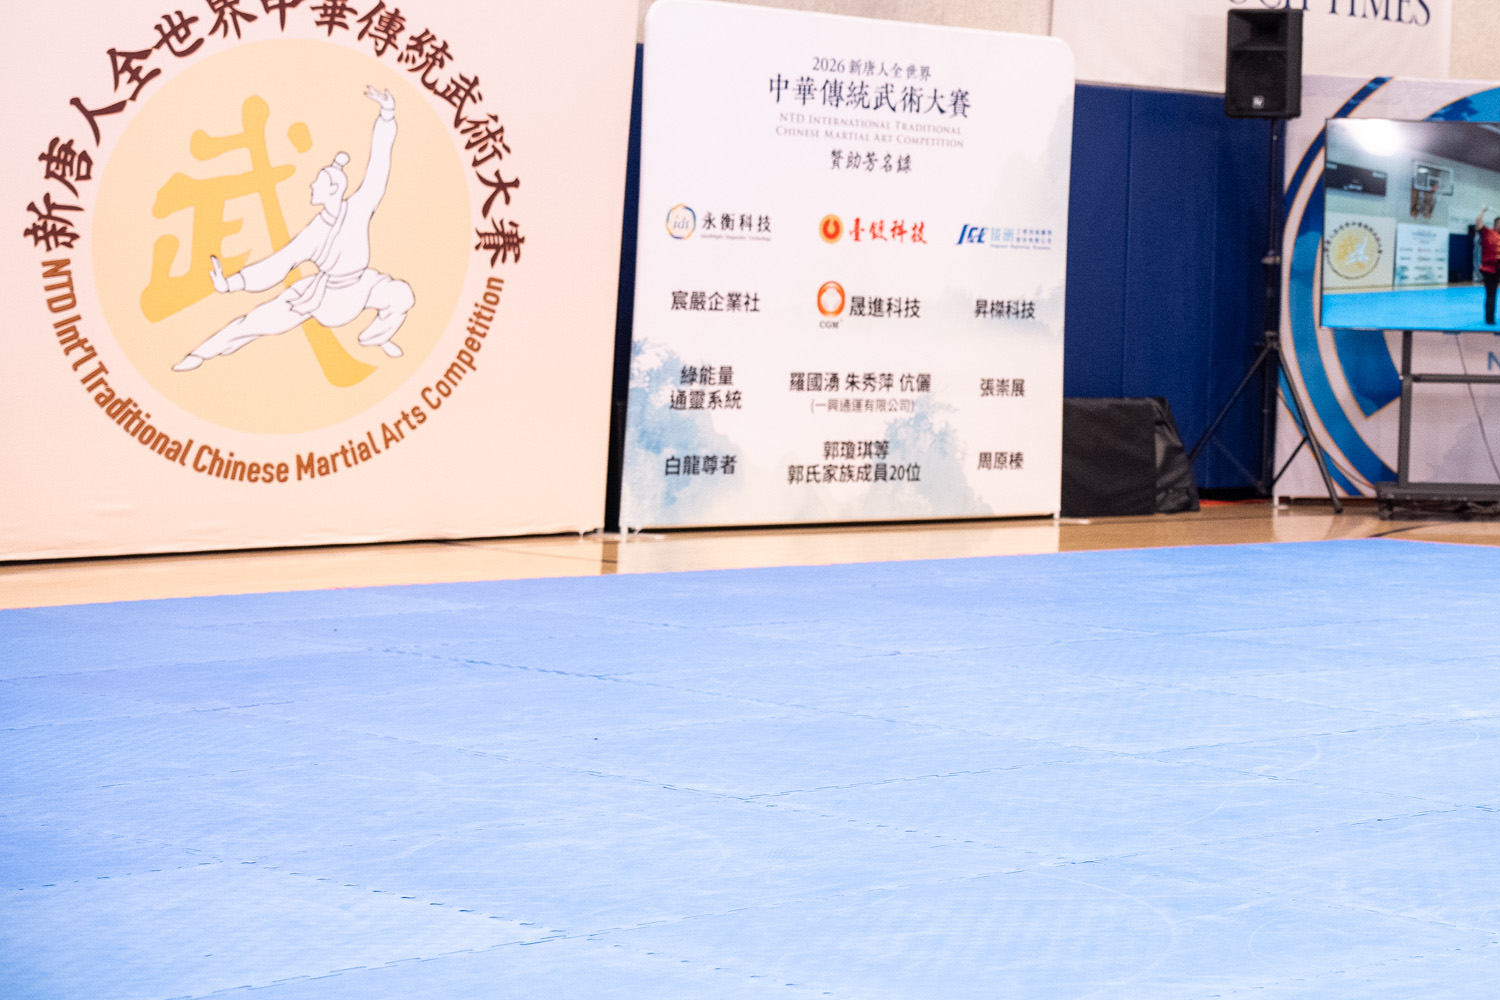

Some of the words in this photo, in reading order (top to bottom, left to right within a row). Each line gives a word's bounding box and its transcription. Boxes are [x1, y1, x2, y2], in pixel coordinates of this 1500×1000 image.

[812, 56, 846, 74] 2026
[849, 58, 932, 82] 新唐人全世界
[769, 73, 971, 119] 中華傳統武術大賽
[779, 112, 805, 124] NTD
[808, 114, 891, 131] INTERNATIONAL
[895, 120, 962, 136] TRADITIONAL
[775, 126, 820, 139] CHINESE
[824, 130, 870, 143] MARTIAL
[873, 133, 893, 144] ART
[896, 134, 965, 149] COMPETITION
[702, 211, 771, 233] 永衡科技
[41, 258, 77, 313] NTD
[849, 296, 921, 319] 晟進科技
[53, 314, 98, 372] Int'l
[420, 276, 505, 410] Competition
[680, 365, 734, 386] 綠能量
[845, 372, 894, 392] 朱秀萍
[899, 372, 932, 393] 伉儷
[669, 389, 743, 411] 通靈系統
[80, 360, 194, 467] Traditional
[380, 405, 428, 450] Arts
[192, 444, 290, 484] Chinese
[295, 430, 382, 481] Martial
[664, 454, 738, 476] 白龍尊者
[787, 462, 922, 484] 郭氏家族成員20位
